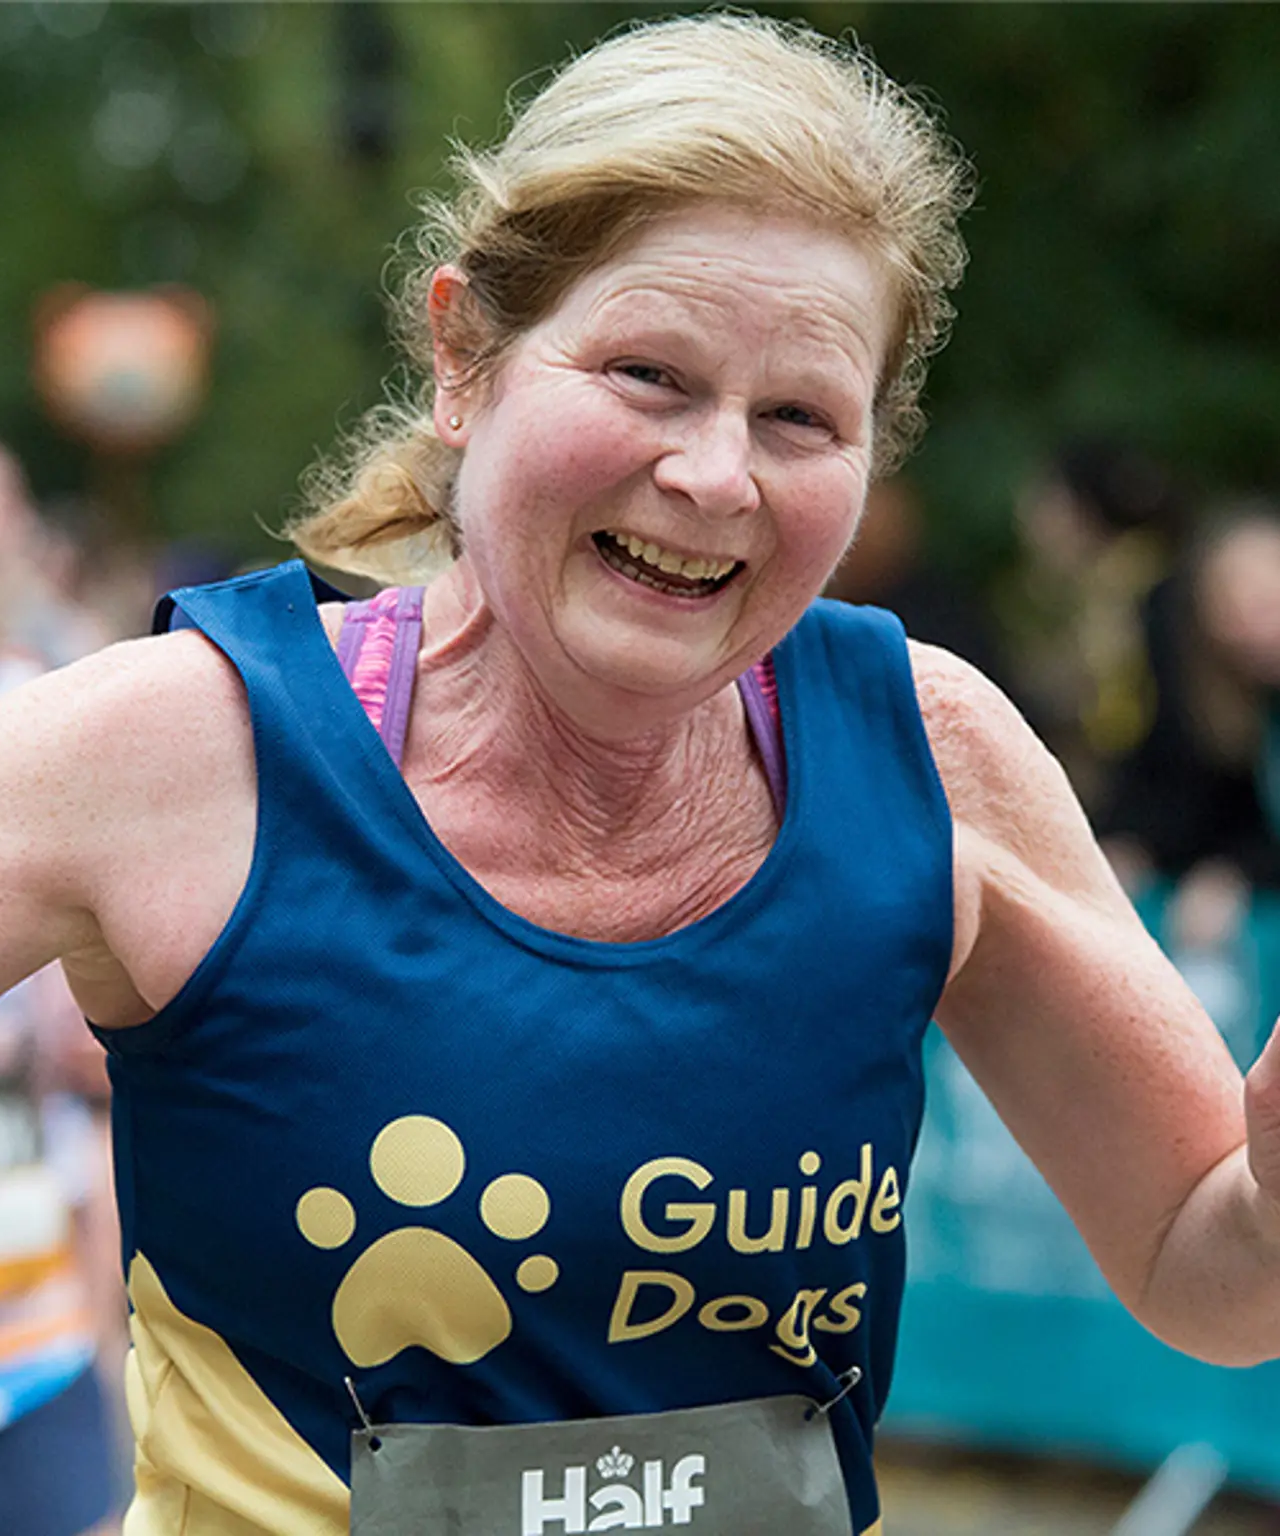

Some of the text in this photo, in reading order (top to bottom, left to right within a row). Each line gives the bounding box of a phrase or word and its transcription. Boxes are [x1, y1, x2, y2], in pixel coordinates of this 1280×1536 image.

[621, 1142, 901, 1253] Guide
[608, 1271, 867, 1367] Dogs
[522, 1454, 706, 1536] Half
